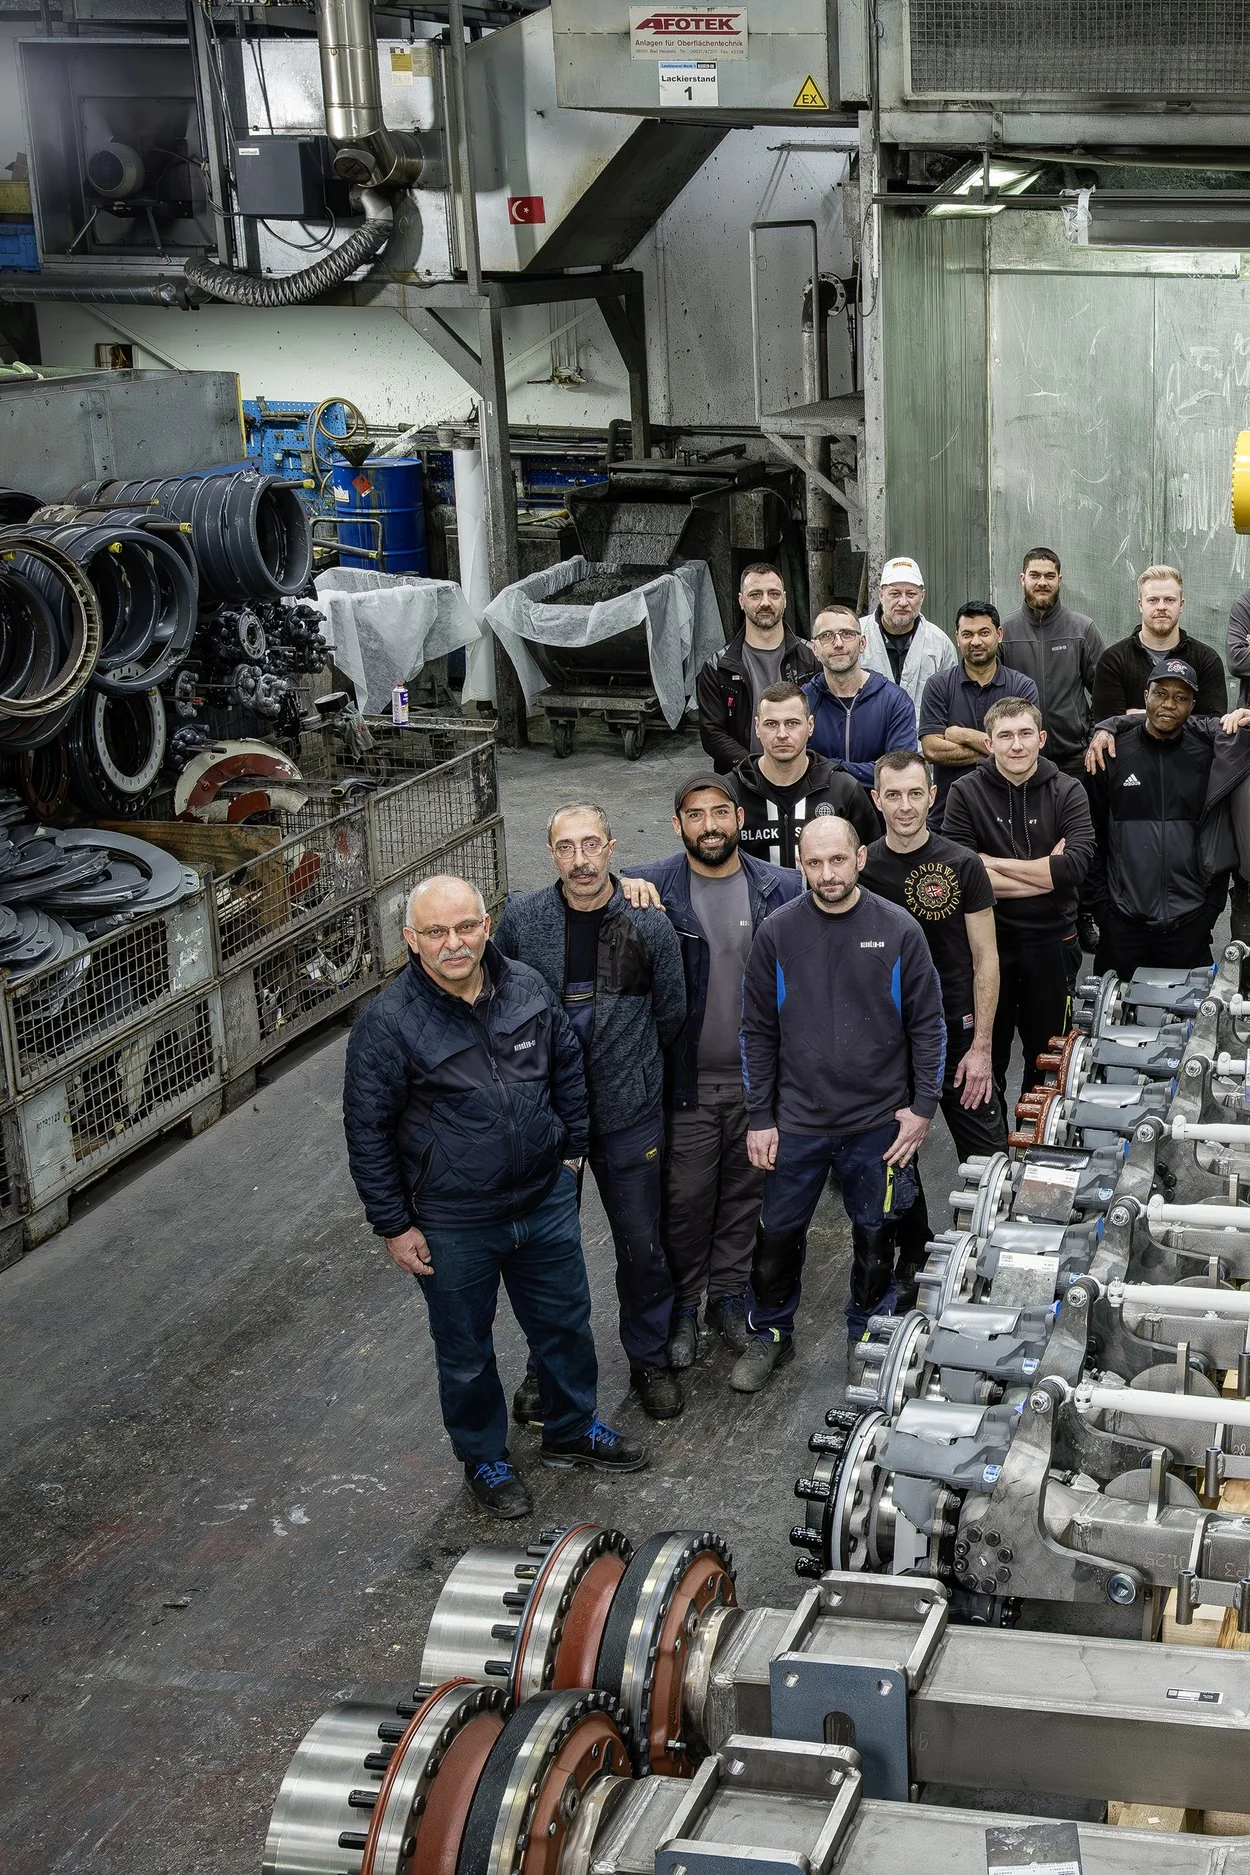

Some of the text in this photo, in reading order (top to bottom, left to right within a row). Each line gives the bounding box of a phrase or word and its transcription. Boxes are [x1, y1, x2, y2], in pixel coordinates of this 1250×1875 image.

[635, 18, 734, 30] AFOTEK
[684, 86, 692, 100] 1
[802, 94, 818, 104] EX
[740, 828, 780, 840] BLACK
